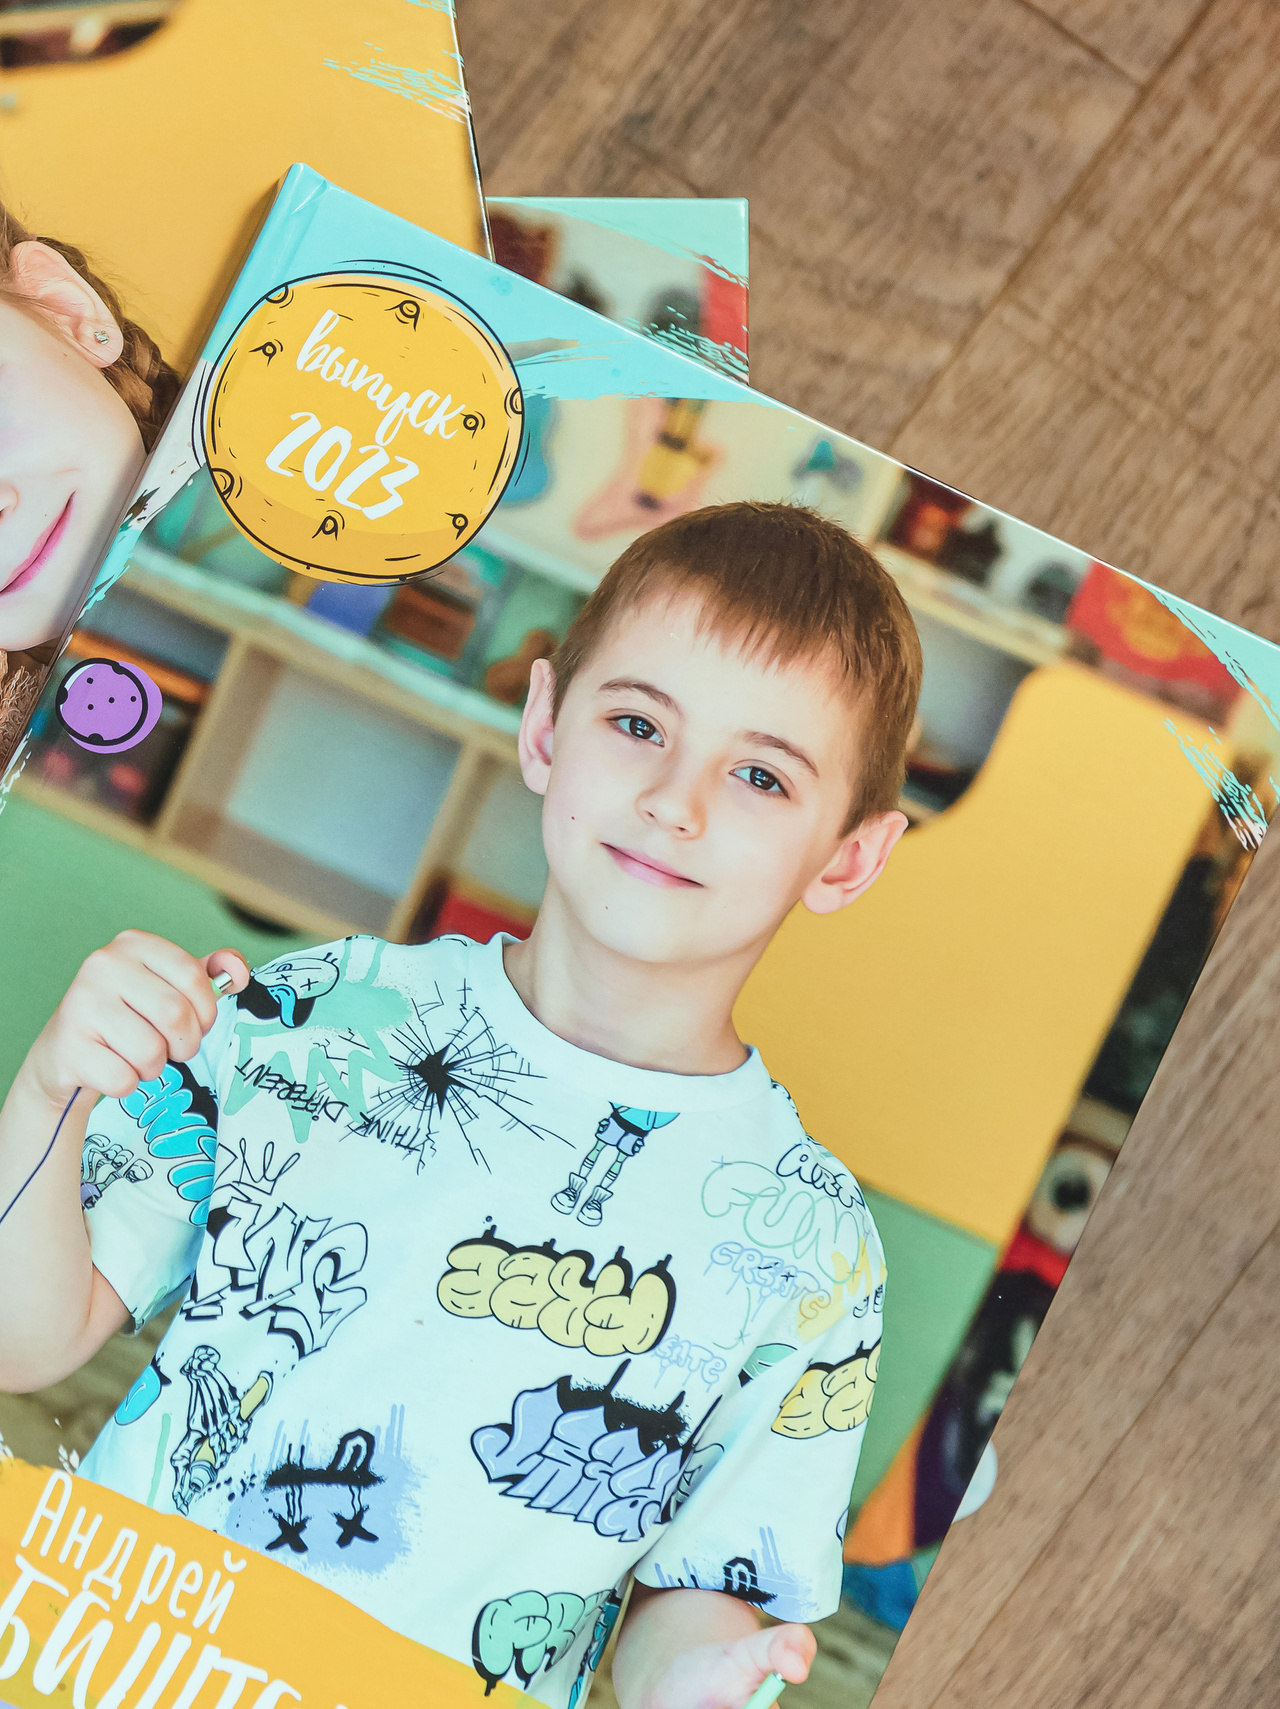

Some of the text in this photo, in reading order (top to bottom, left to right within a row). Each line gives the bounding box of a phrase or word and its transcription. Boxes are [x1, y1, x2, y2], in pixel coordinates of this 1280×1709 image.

[265, 412, 420, 520] 2023
[701, 1160, 863, 1286] FUN
[21, 1470, 246, 1634] Андрей
